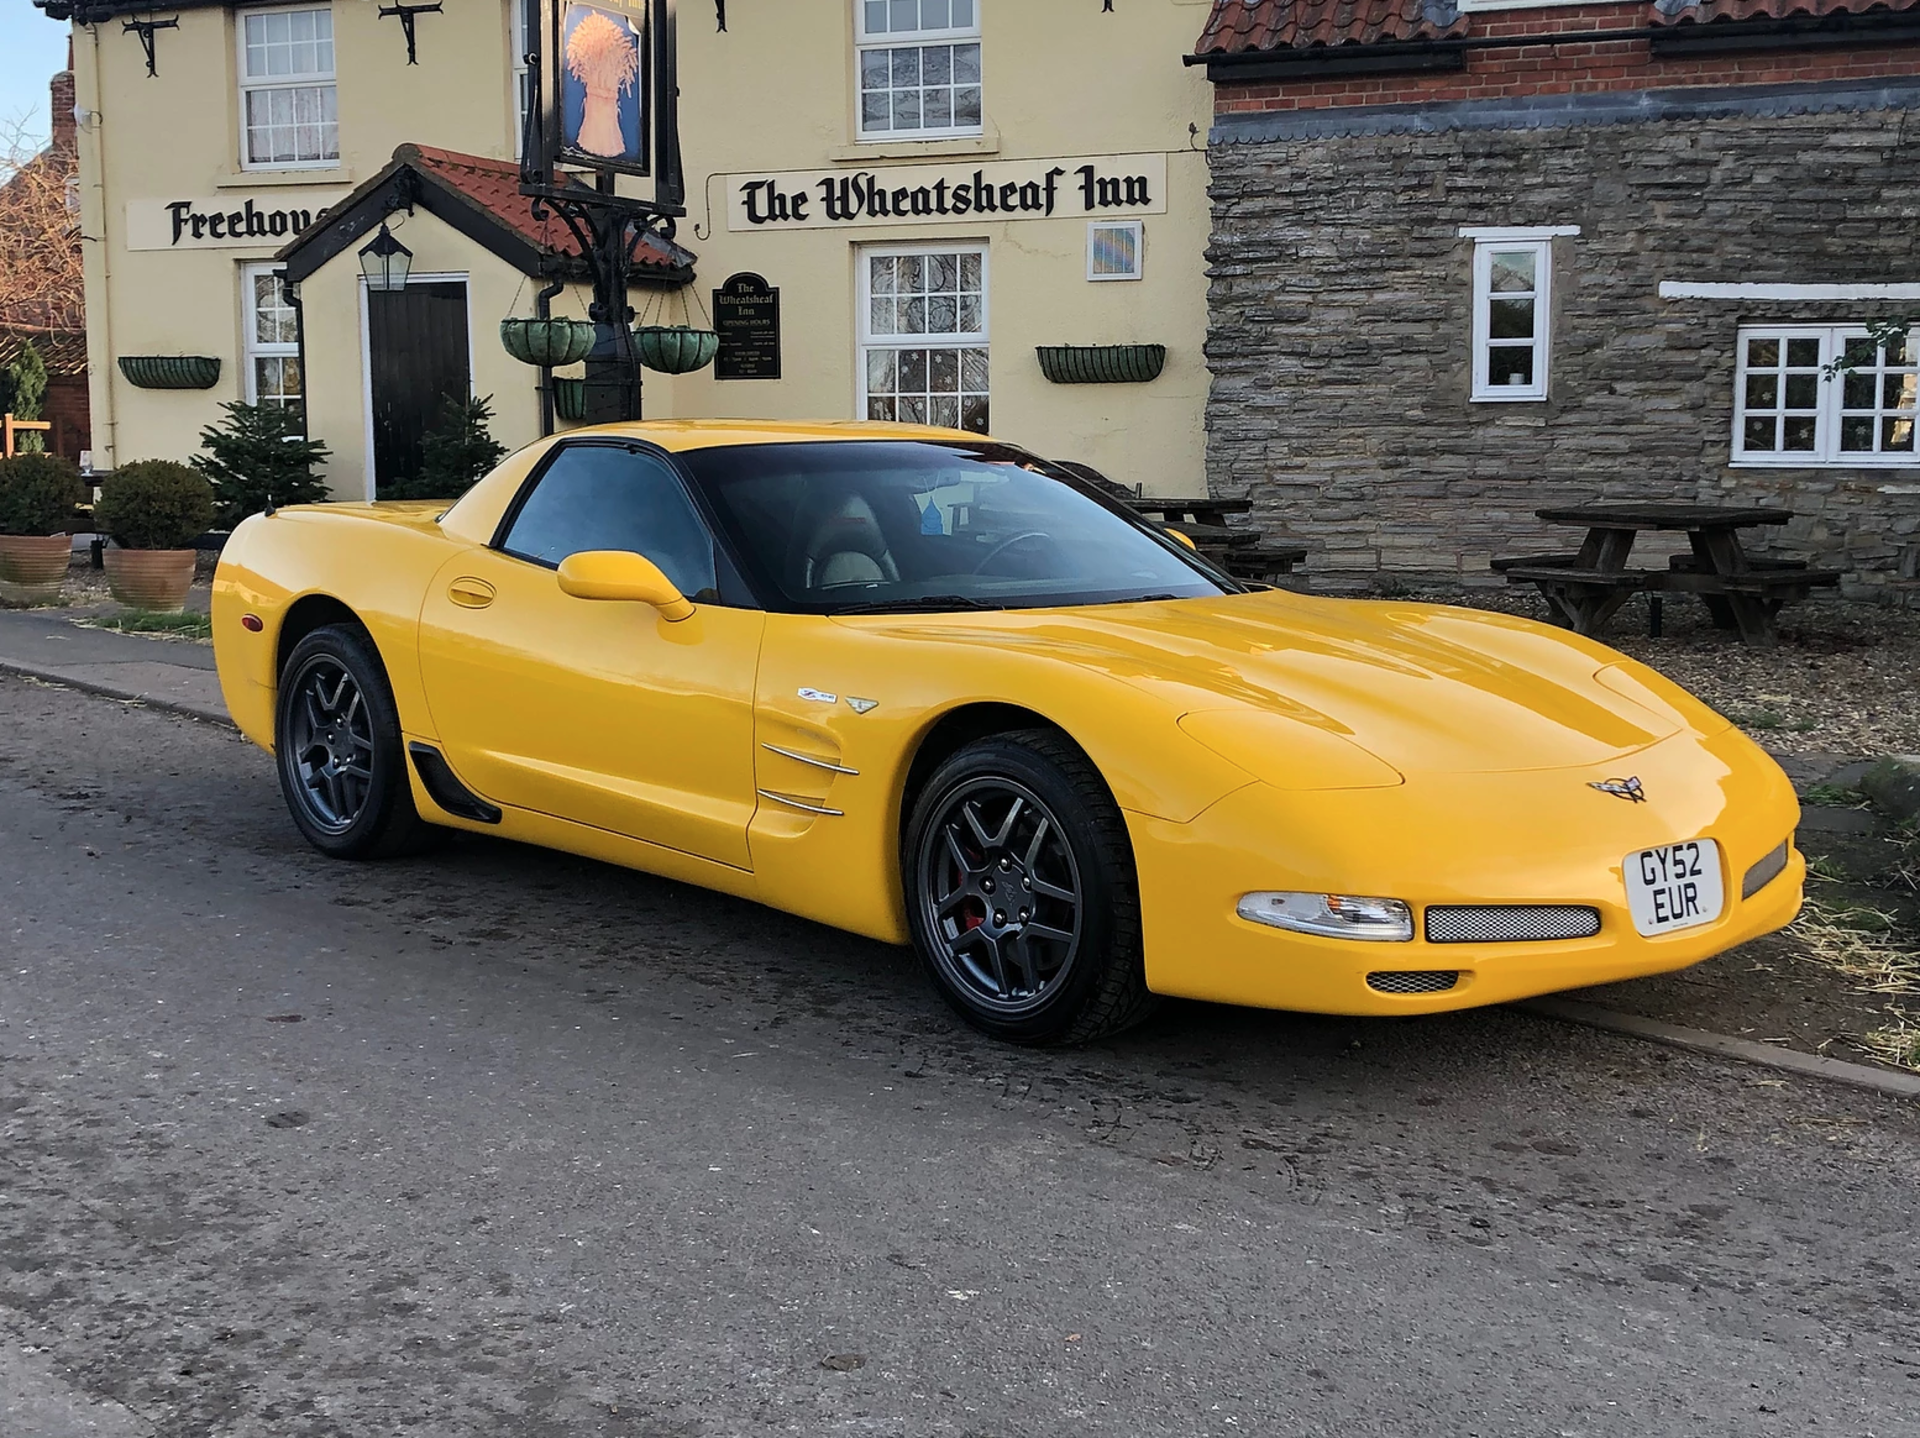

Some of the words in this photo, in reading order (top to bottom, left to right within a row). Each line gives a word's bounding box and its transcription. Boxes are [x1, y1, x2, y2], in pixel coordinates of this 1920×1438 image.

[739, 178, 810, 224] The
[815, 165, 1066, 221] Wheatsheaf
[1074, 164, 1152, 211] Inn
[718, 293, 774, 305] Wheatsheaf
[736, 282, 755, 294] The
[737, 305, 755, 316] Inn
[1640, 842, 1703, 886] GY52
[1653, 882, 1700, 924] EUR
